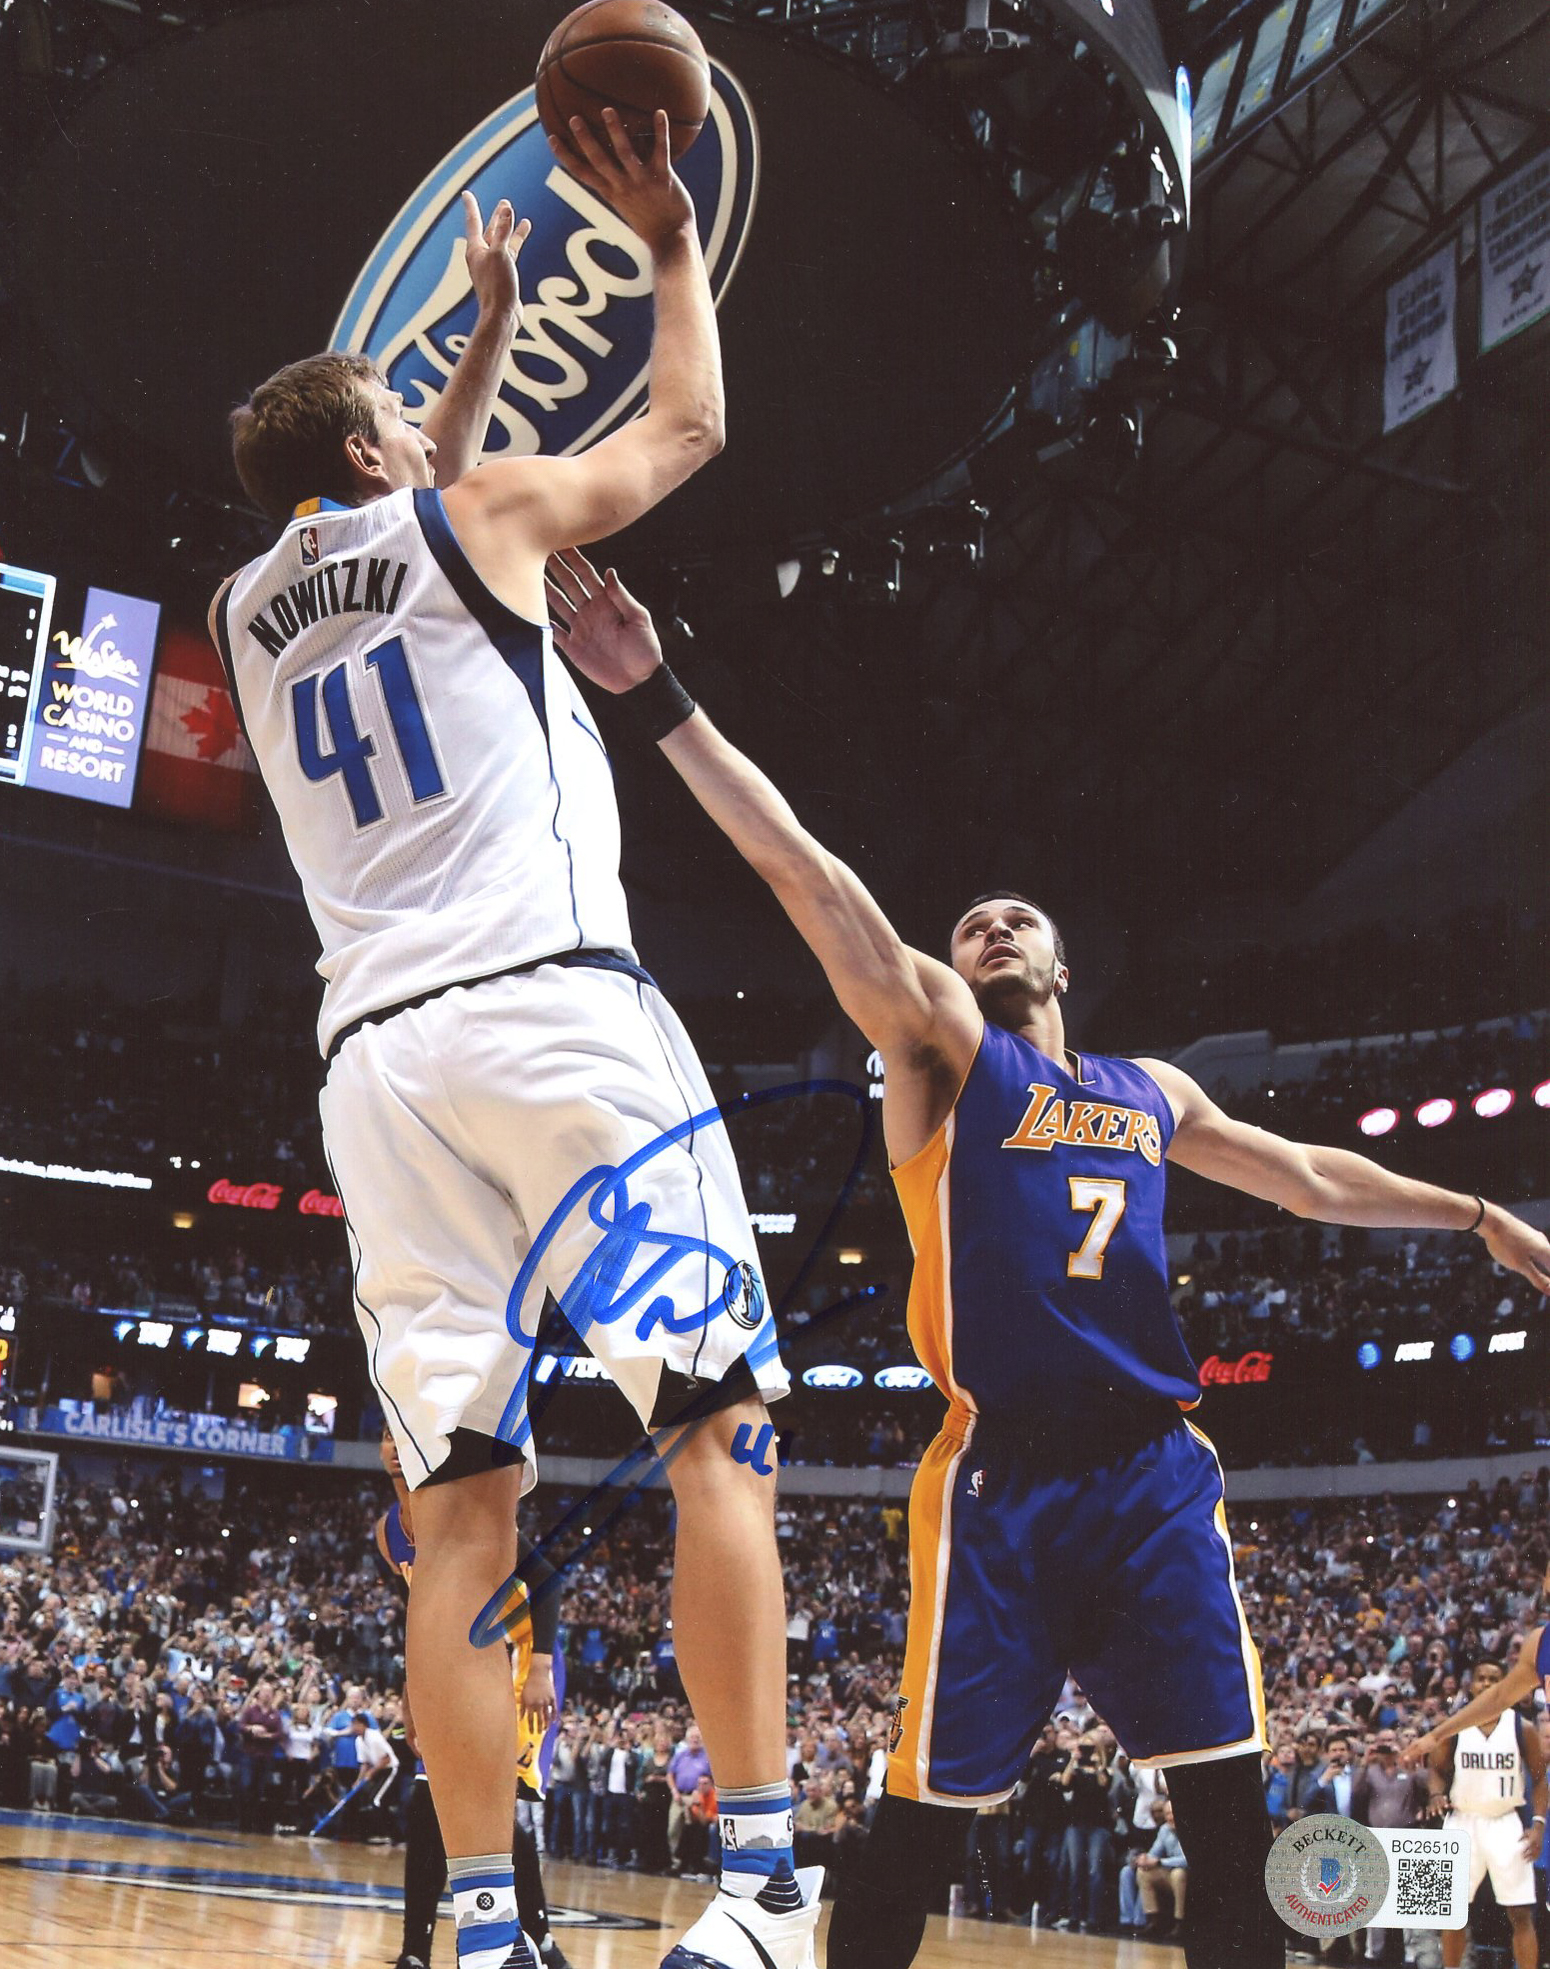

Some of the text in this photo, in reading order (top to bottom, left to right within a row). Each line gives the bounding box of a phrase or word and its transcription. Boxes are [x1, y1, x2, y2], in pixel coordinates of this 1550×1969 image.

[372, 165, 656, 460] Ford
[247, 557, 408, 659] NOWITZKI
[51, 680, 134, 718] WORLD
[43, 703, 135, 742] CASINO
[289, 631, 452, 832] 41
[40, 746, 126, 783] RESORT
[69, 736, 104, 753] AND
[1001, 1083, 1161, 1166] LAKERS
[1067, 1177, 1125, 1280] 7
[64, 1411, 287, 1456] CARLISLE'S CORNER
[1461, 1752, 1514, 1770] DALLAS
[1499, 1776, 1514, 1797] 11
